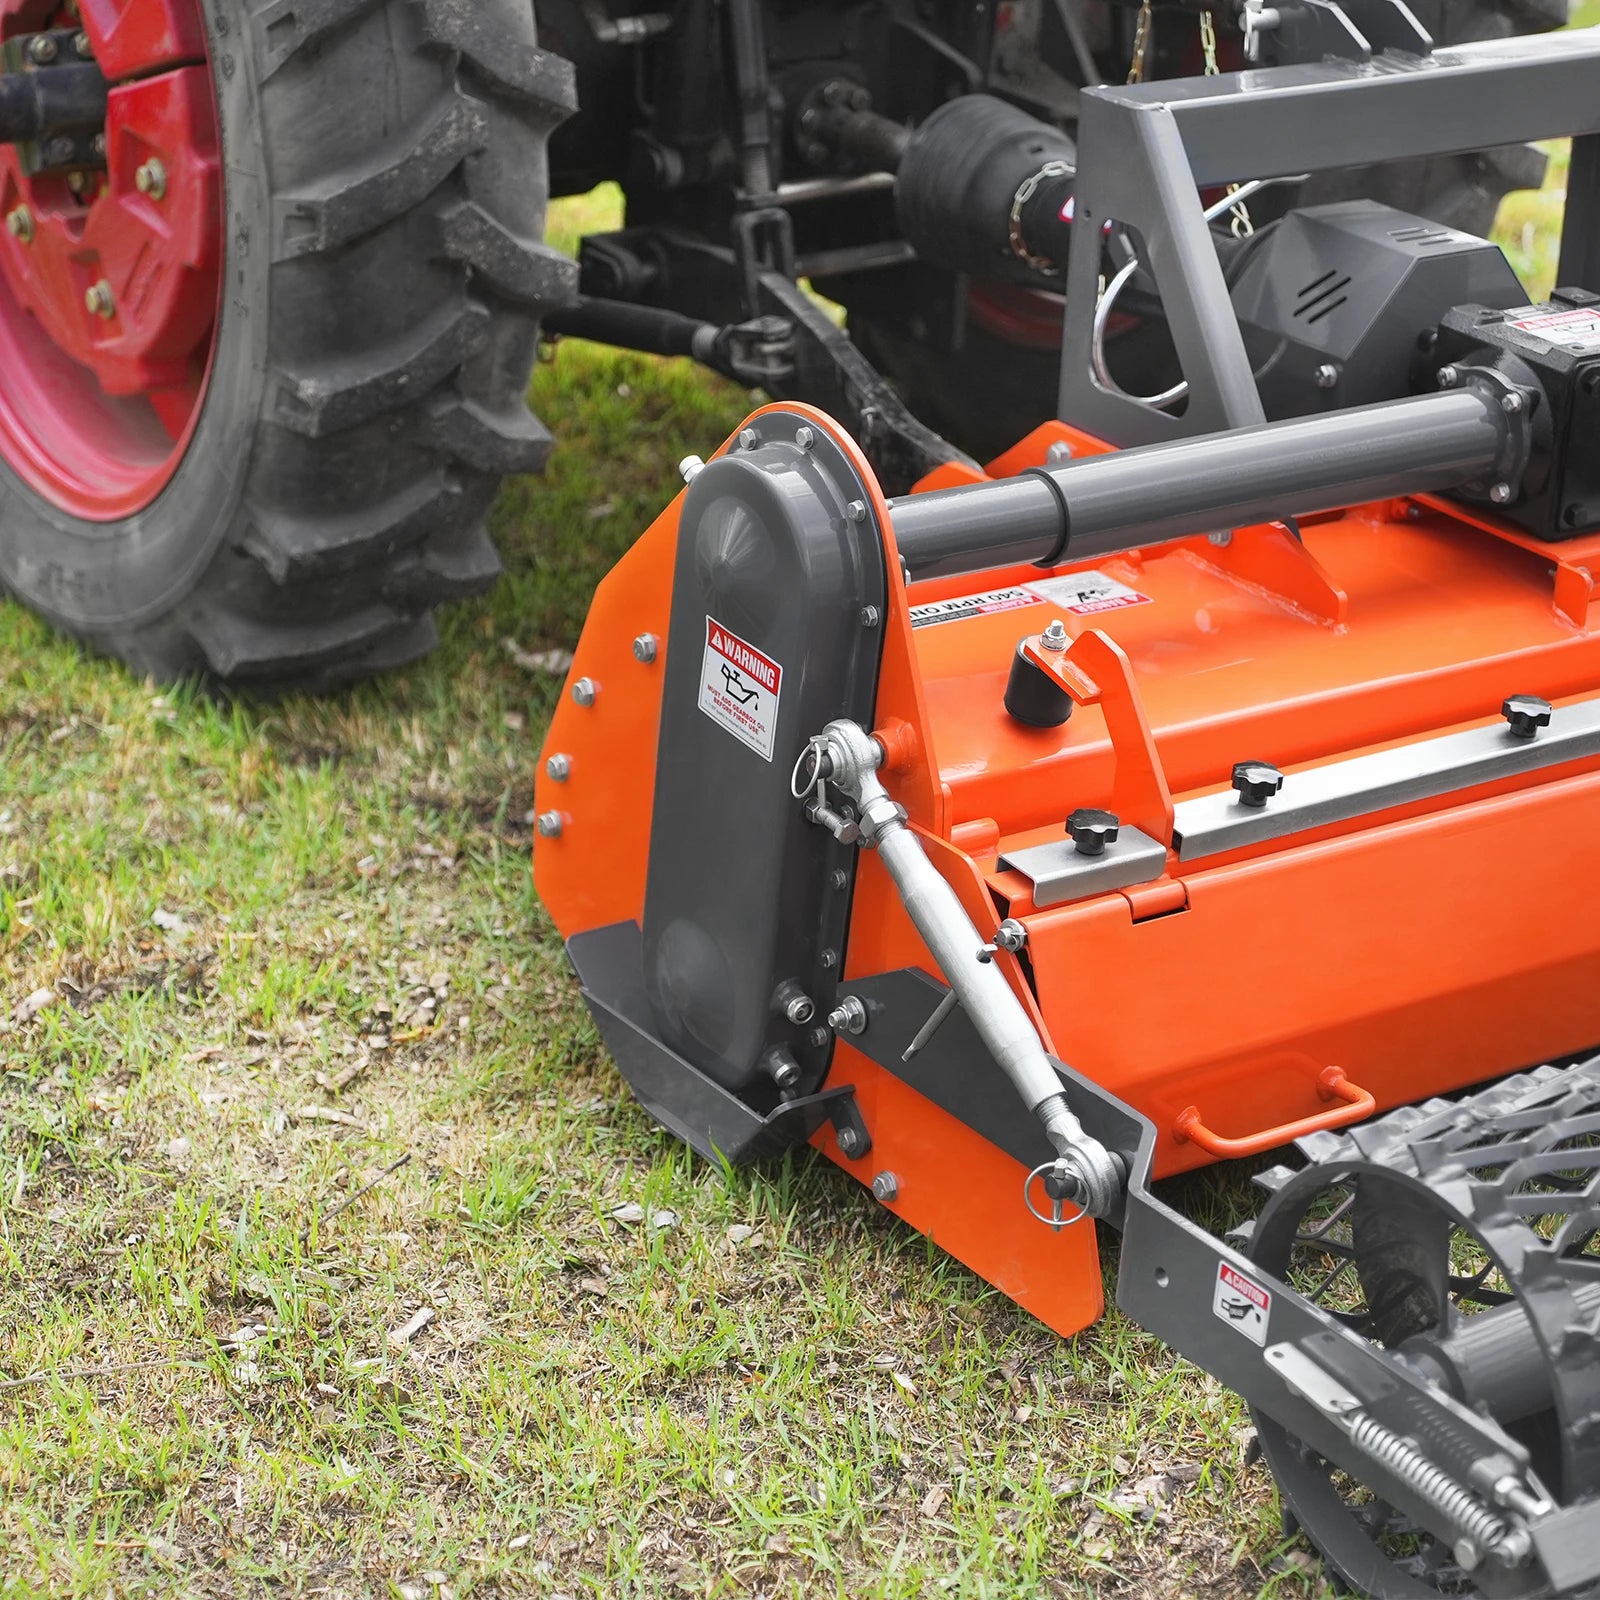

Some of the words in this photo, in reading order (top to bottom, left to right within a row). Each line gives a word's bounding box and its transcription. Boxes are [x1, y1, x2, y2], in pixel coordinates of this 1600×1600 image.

[942, 597, 986, 611] RPM
[988, 590, 1024, 601] 540
[1076, 598, 1128, 613] DANGER
[910, 606, 940, 619] ON
[723, 635, 776, 689] WARNING
[707, 684, 720, 697] MUST
[722, 696, 732, 706] ADD
[732, 704, 756, 725] GEARBOX
[757, 722, 766, 733] OIL
[713, 697, 732, 715] BEFORE
[733, 713, 747, 726] FIRST
[748, 723, 759, 735] USE
[1233, 1274, 1265, 1306] CAUTION
